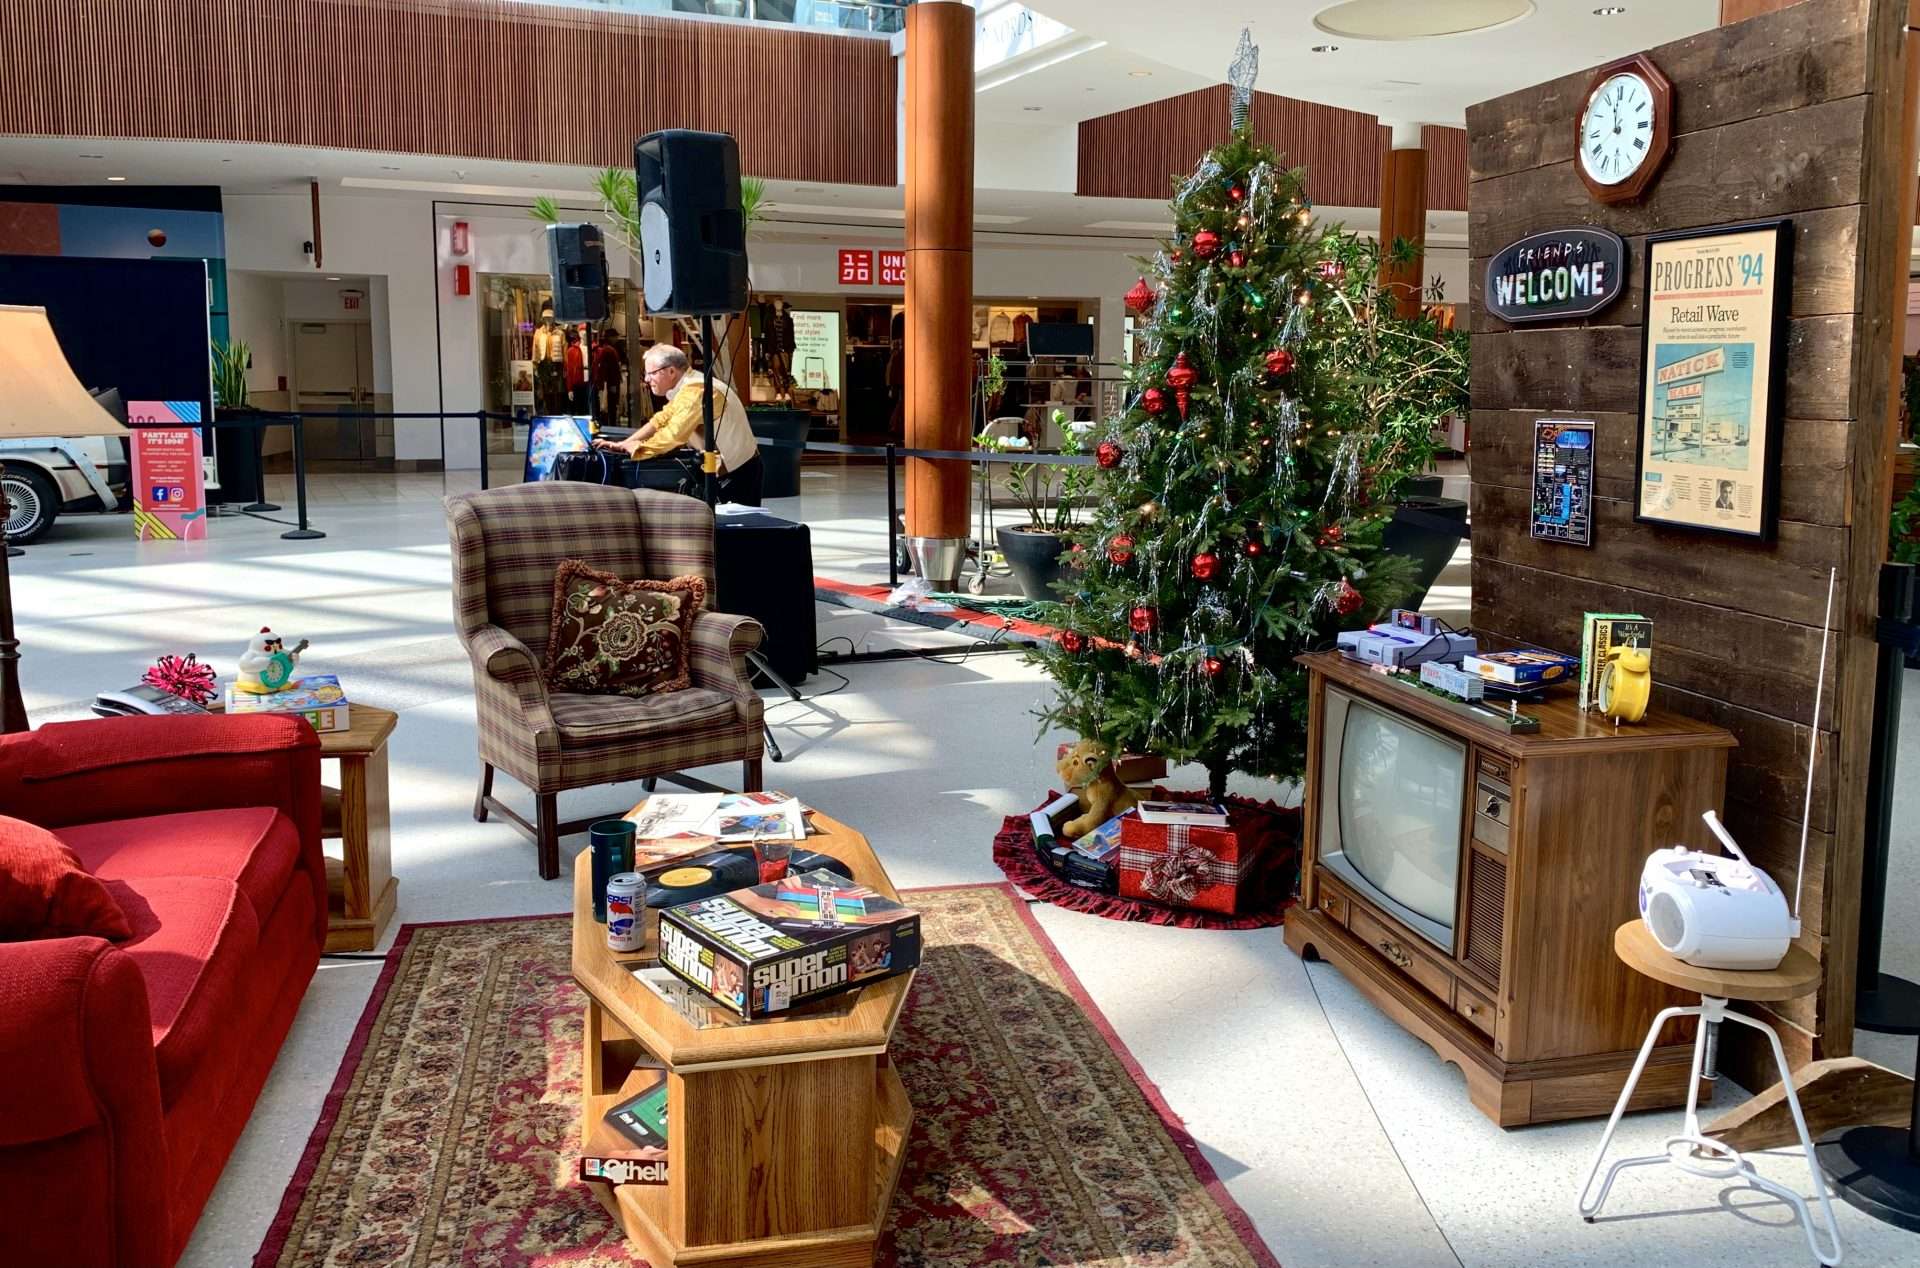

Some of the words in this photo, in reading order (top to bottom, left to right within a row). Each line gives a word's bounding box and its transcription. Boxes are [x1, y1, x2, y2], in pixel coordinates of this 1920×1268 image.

[882, 255, 906, 267] UNI
[1654, 256, 1734, 291] PROGRESS
[1737, 252, 1764, 286] '94
[1496, 261, 1605, 306] WELCOME
[1671, 305, 1704, 323] Retail
[1706, 304, 1740, 322] Wave
[607, 894, 633, 905] EPSI
[753, 950, 828, 988] super
[603, 1158, 668, 1182] Othell
